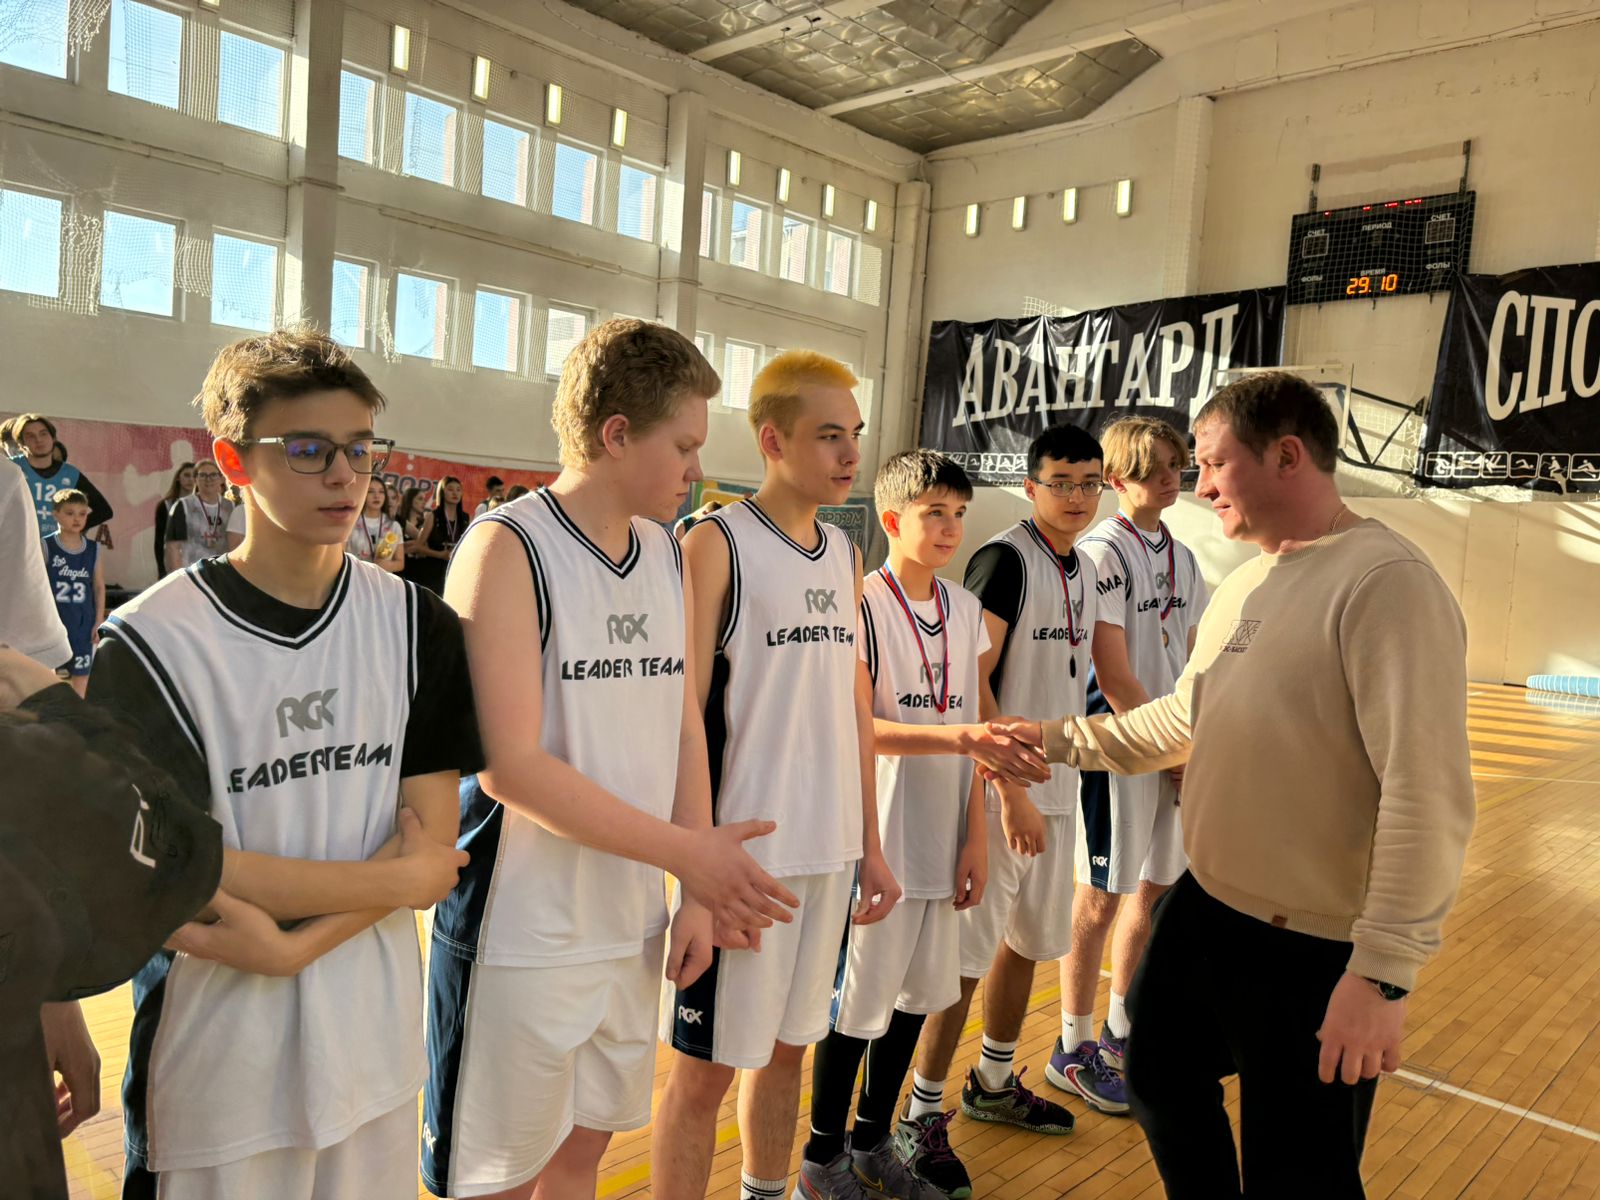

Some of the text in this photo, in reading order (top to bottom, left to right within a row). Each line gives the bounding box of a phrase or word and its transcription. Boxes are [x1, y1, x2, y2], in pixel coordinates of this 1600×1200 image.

[1362, 222, 1392, 232] ПЕРИОД
[951, 303, 1240, 433] АВАНГАРД
[35, 482, 57, 502] 12
[56, 581, 87, 603] 23
[766, 625, 830, 647] LEADER
[75, 655, 91, 669] 23
[562, 656, 684, 680] LEADER TEAM
